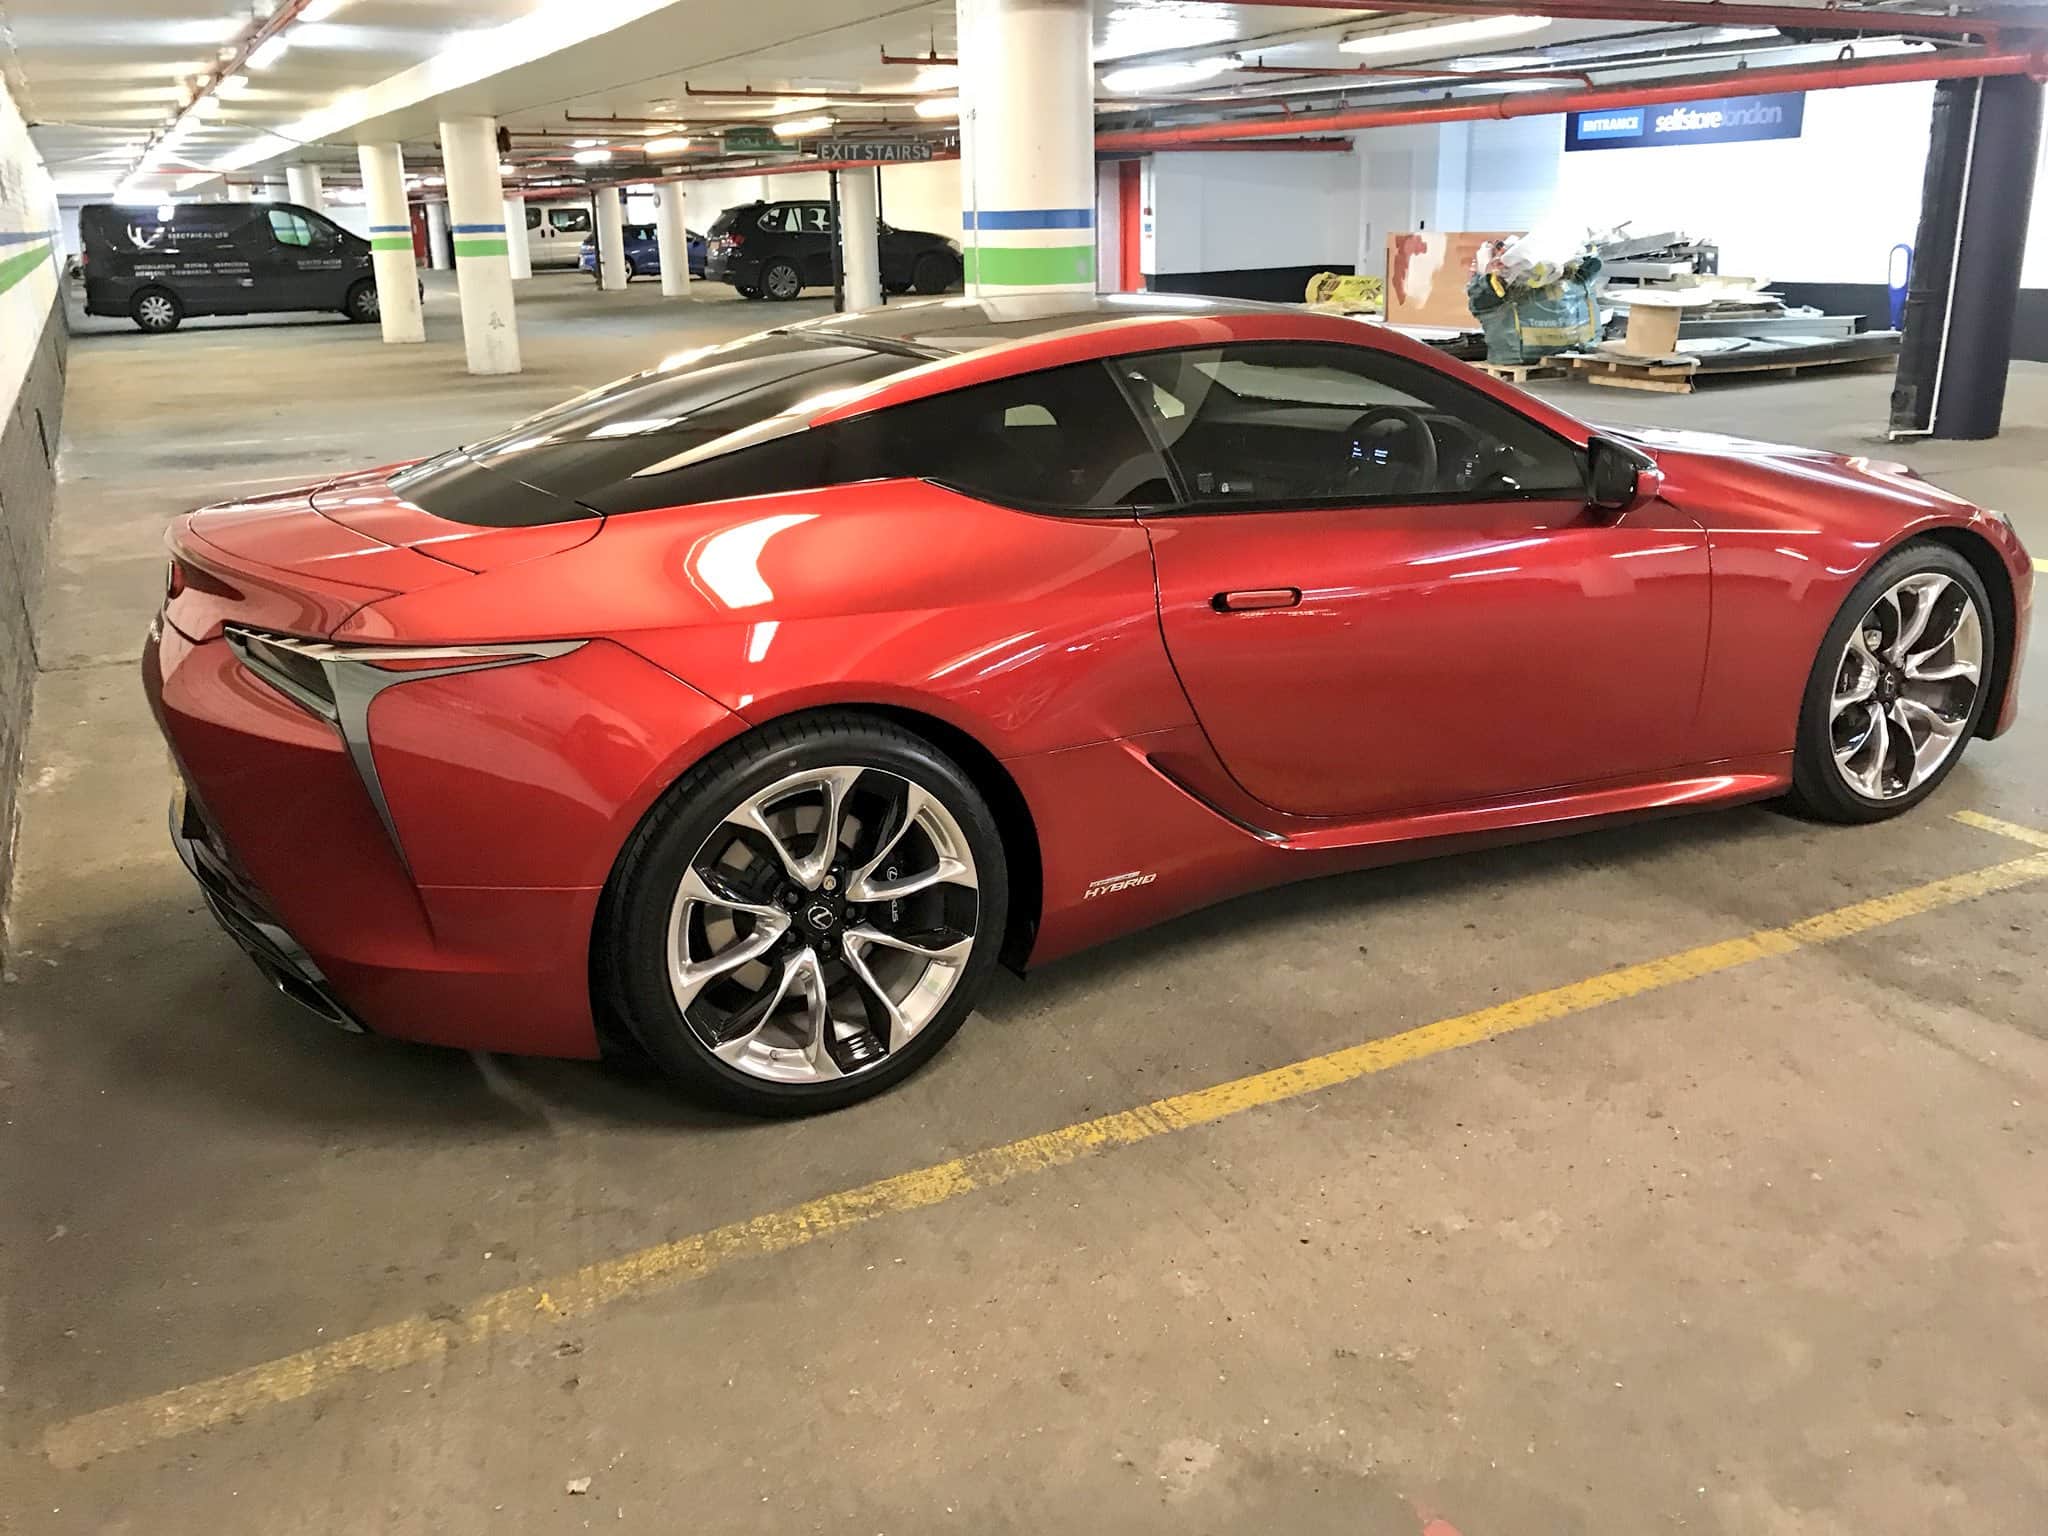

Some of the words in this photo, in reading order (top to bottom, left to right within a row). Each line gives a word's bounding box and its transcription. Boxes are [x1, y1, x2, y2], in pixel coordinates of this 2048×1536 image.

[1583, 116, 1639, 132] ENTRANCE
[821, 144, 858, 160] EXIT
[865, 144, 921, 160] STAIRS
[1083, 873, 1157, 899] HYBRID
